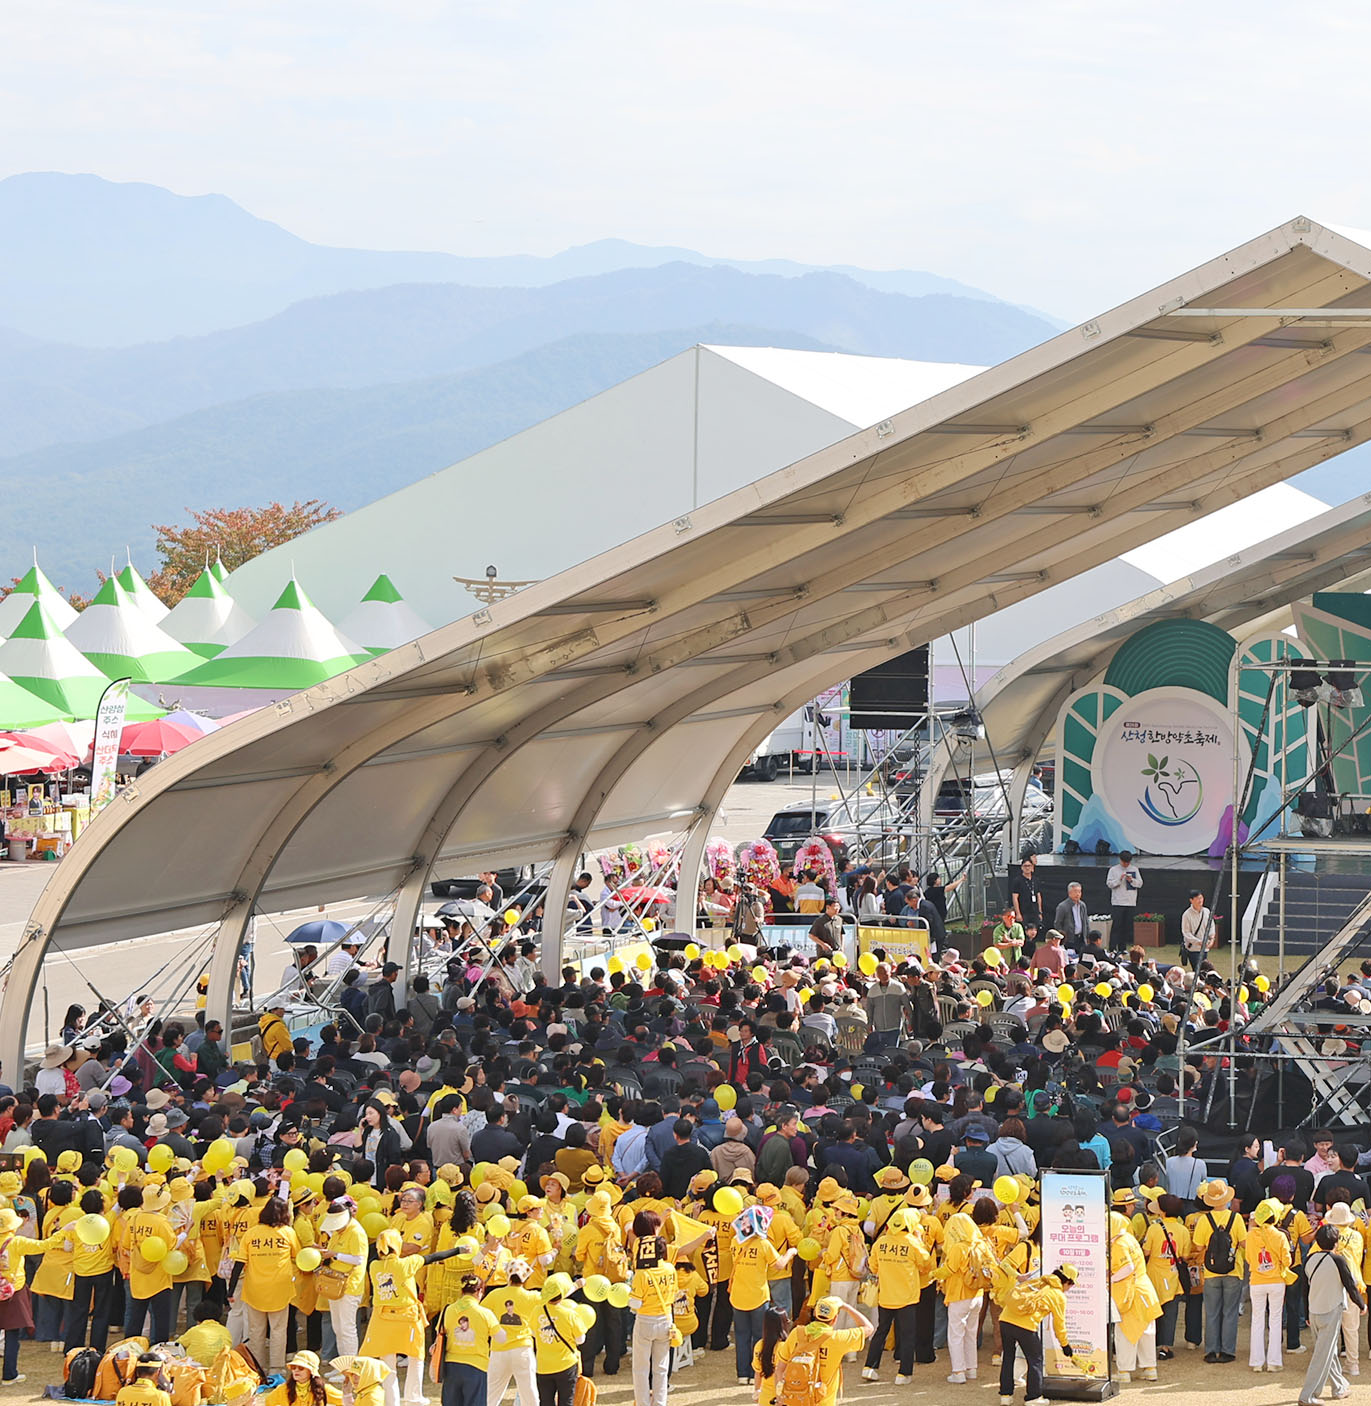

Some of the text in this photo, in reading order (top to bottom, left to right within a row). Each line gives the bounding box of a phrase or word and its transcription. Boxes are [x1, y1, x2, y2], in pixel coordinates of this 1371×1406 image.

[1120, 729, 1218, 747] 산청한방약초축제
[1061, 1225, 1085, 1234] 오늘의
[251, 1238, 286, 1249] 박서진
[1050, 1233, 1099, 1243] 무대 프로그램
[879, 1243, 909, 1256] 박서진
